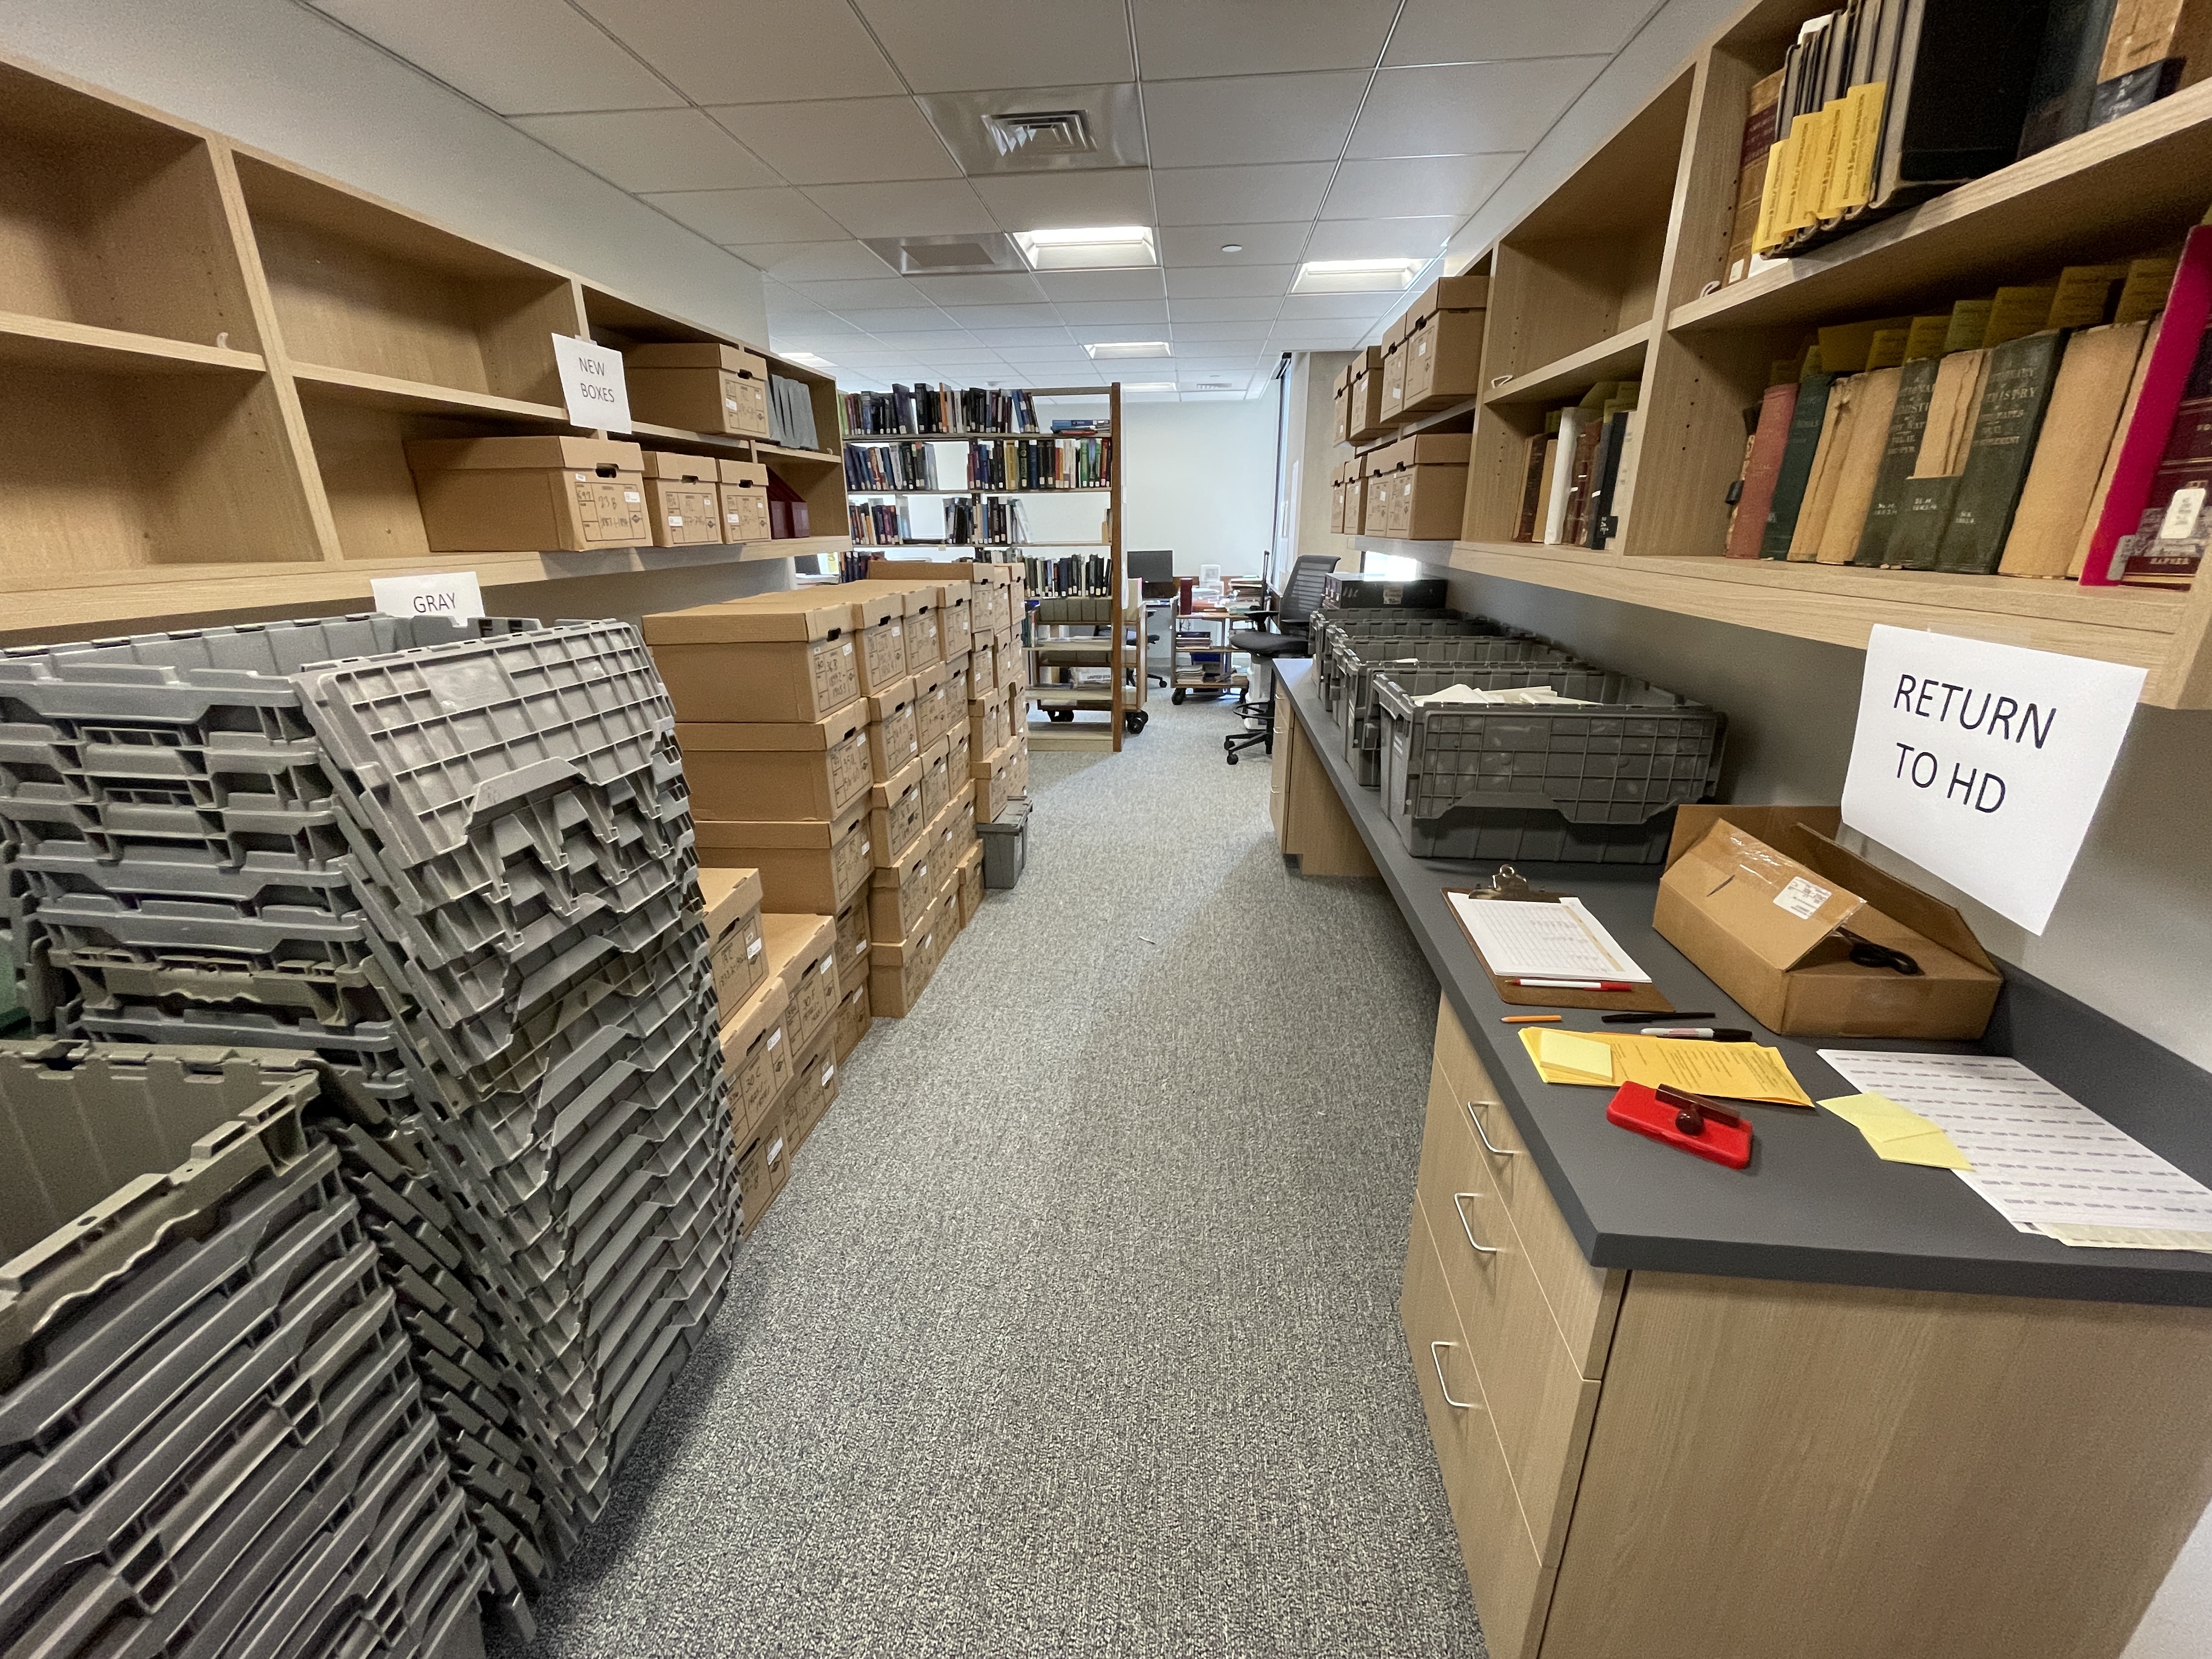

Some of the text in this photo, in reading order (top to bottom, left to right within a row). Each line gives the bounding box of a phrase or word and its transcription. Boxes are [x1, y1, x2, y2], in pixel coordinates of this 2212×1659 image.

[579, 357, 605, 376] NEW
[580, 383, 614, 402] BOXES
[413, 592, 456, 613] GRAY
[1893, 674, 2057, 749] RETURN
[1896, 742, 2006, 814] TO HD
